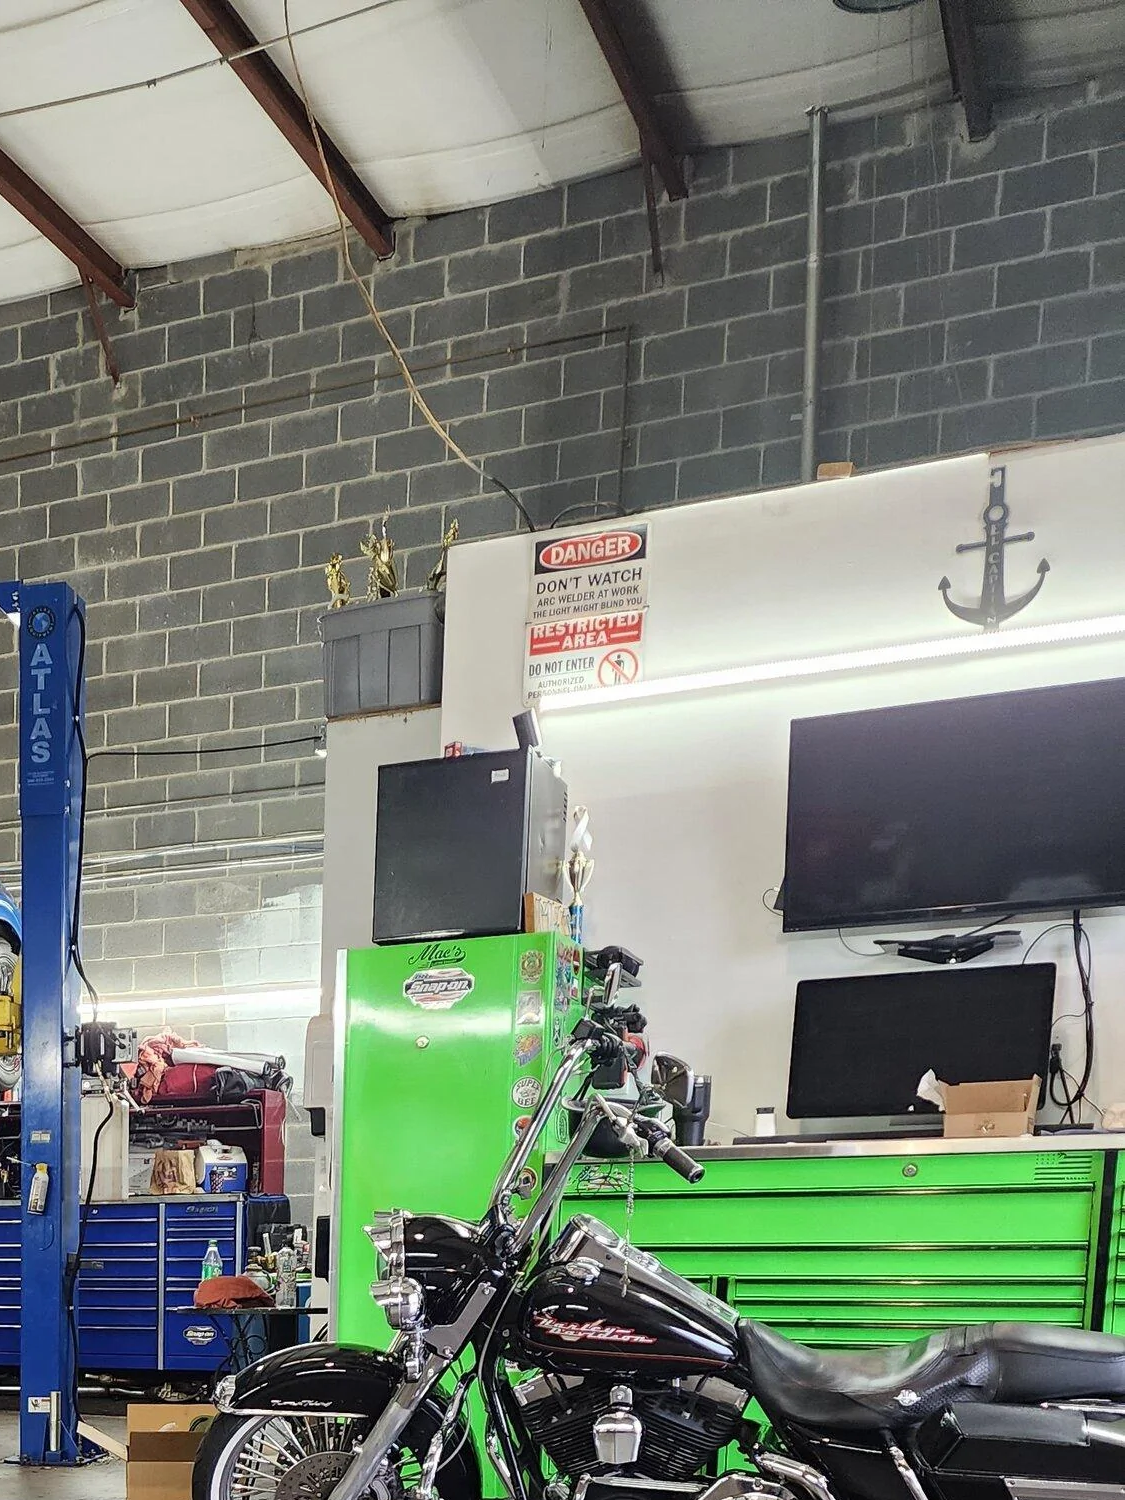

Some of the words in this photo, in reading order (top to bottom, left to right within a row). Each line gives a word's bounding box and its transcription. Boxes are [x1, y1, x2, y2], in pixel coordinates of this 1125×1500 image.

[550, 536, 631, 564] DANGER
[536, 576, 582, 595] DON'T
[588, 567, 642, 587] WATCH
[533, 610, 548, 619] THE
[549, 606, 571, 617] LIGHT
[573, 603, 598, 614] MIGHT
[601, 599, 624, 610] BLIND
[626, 597, 643, 607] YOU
[537, 595, 556, 608] ARC
[558, 590, 595, 606] WELDER
[597, 588, 610, 600] AT
[611, 585, 639, 598] WORK
[533, 613, 639, 639] RESTRICTED
[561, 632, 608, 650] AREA
[529, 663, 543, 677] DO
[544, 660, 563, 674] NOT
[566, 656, 595, 671] ENTER
[538, 676, 585, 689] AUTHORIZED
[29, 642, 53, 763] ATLAS
[408, 943, 466, 966] Mac's
